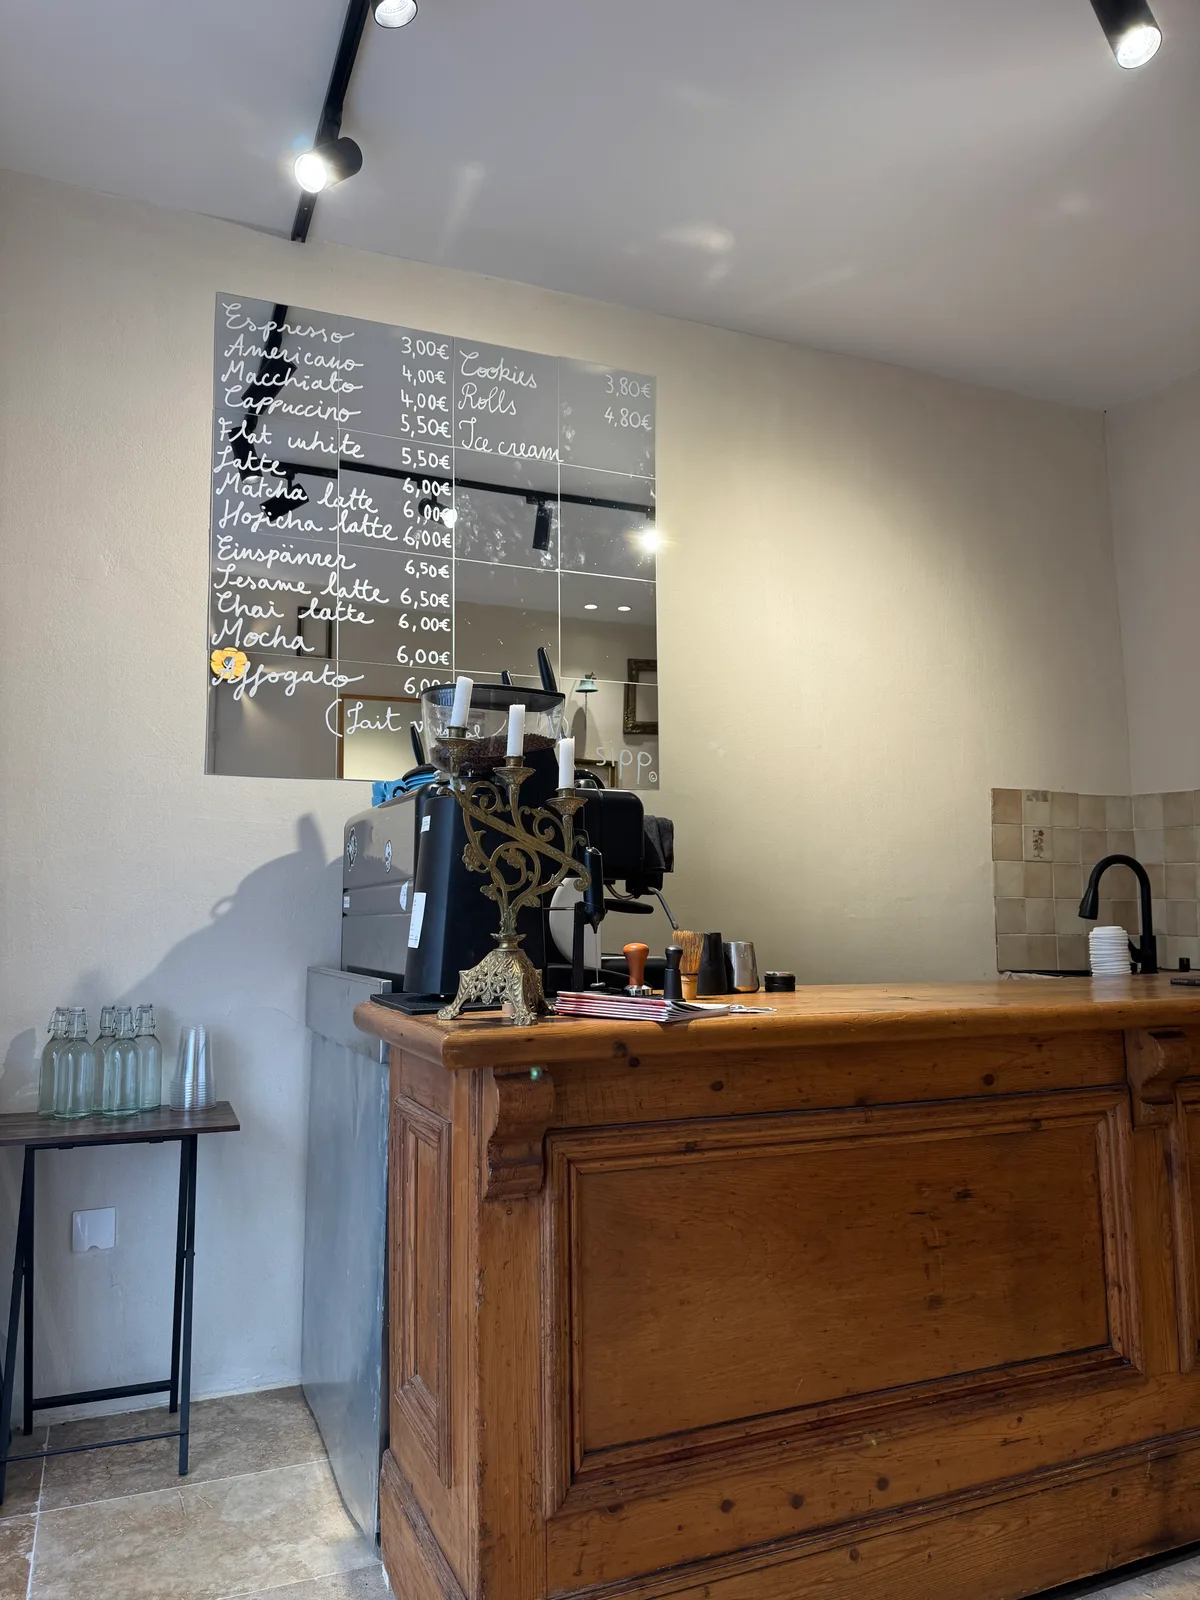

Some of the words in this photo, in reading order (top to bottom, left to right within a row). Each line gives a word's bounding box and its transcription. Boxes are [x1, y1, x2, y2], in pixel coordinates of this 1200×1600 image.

[222, 303, 355, 343] Espresso
[401, 337, 449, 360] 3,00€
[224, 334, 363, 371] Americano
[402, 365, 447, 387] 4,00€
[459, 350, 537, 388] Cookies
[605, 374, 651, 399] 3,80€
[221, 361, 363, 393] Macchiato
[400, 389, 449, 412] 4,00€
[458, 382, 517, 416] Rolls
[604, 406, 652, 431] 4,80€
[224, 385, 361, 422] Cappuccino
[400, 414, 451, 438] 5,50€
[218, 417, 272, 445] Flat
[288, 431, 364, 458] white
[401, 447, 450, 469] 5,50€
[458, 417, 492, 453] Ice
[498, 441, 564, 463] cream
[213, 445, 286, 475] Latte
[402, 478, 451, 498] 6,00€
[216, 473, 307, 501] Matcha
[317, 482, 378, 513] latte
[218, 499, 323, 532] Hojicha
[329, 510, 398, 541] latte
[403, 526, 452, 549] 6,00€
[217, 535, 356, 569] Einspänner
[404, 559, 450, 579] 6,50€
[213, 564, 311, 595] Sesame
[320, 571, 389, 604] latte
[400, 588, 450, 609] 6,50€
[216, 590, 284, 618] Chai
[298, 597, 374, 625] latte
[398, 613, 451, 633] 6,00€
[211, 618, 315, 652] Mocha
[396, 645, 450, 666] 6,00€
[211, 656, 364, 701] Affogato
[403, 676, 451, 699] 6,0
